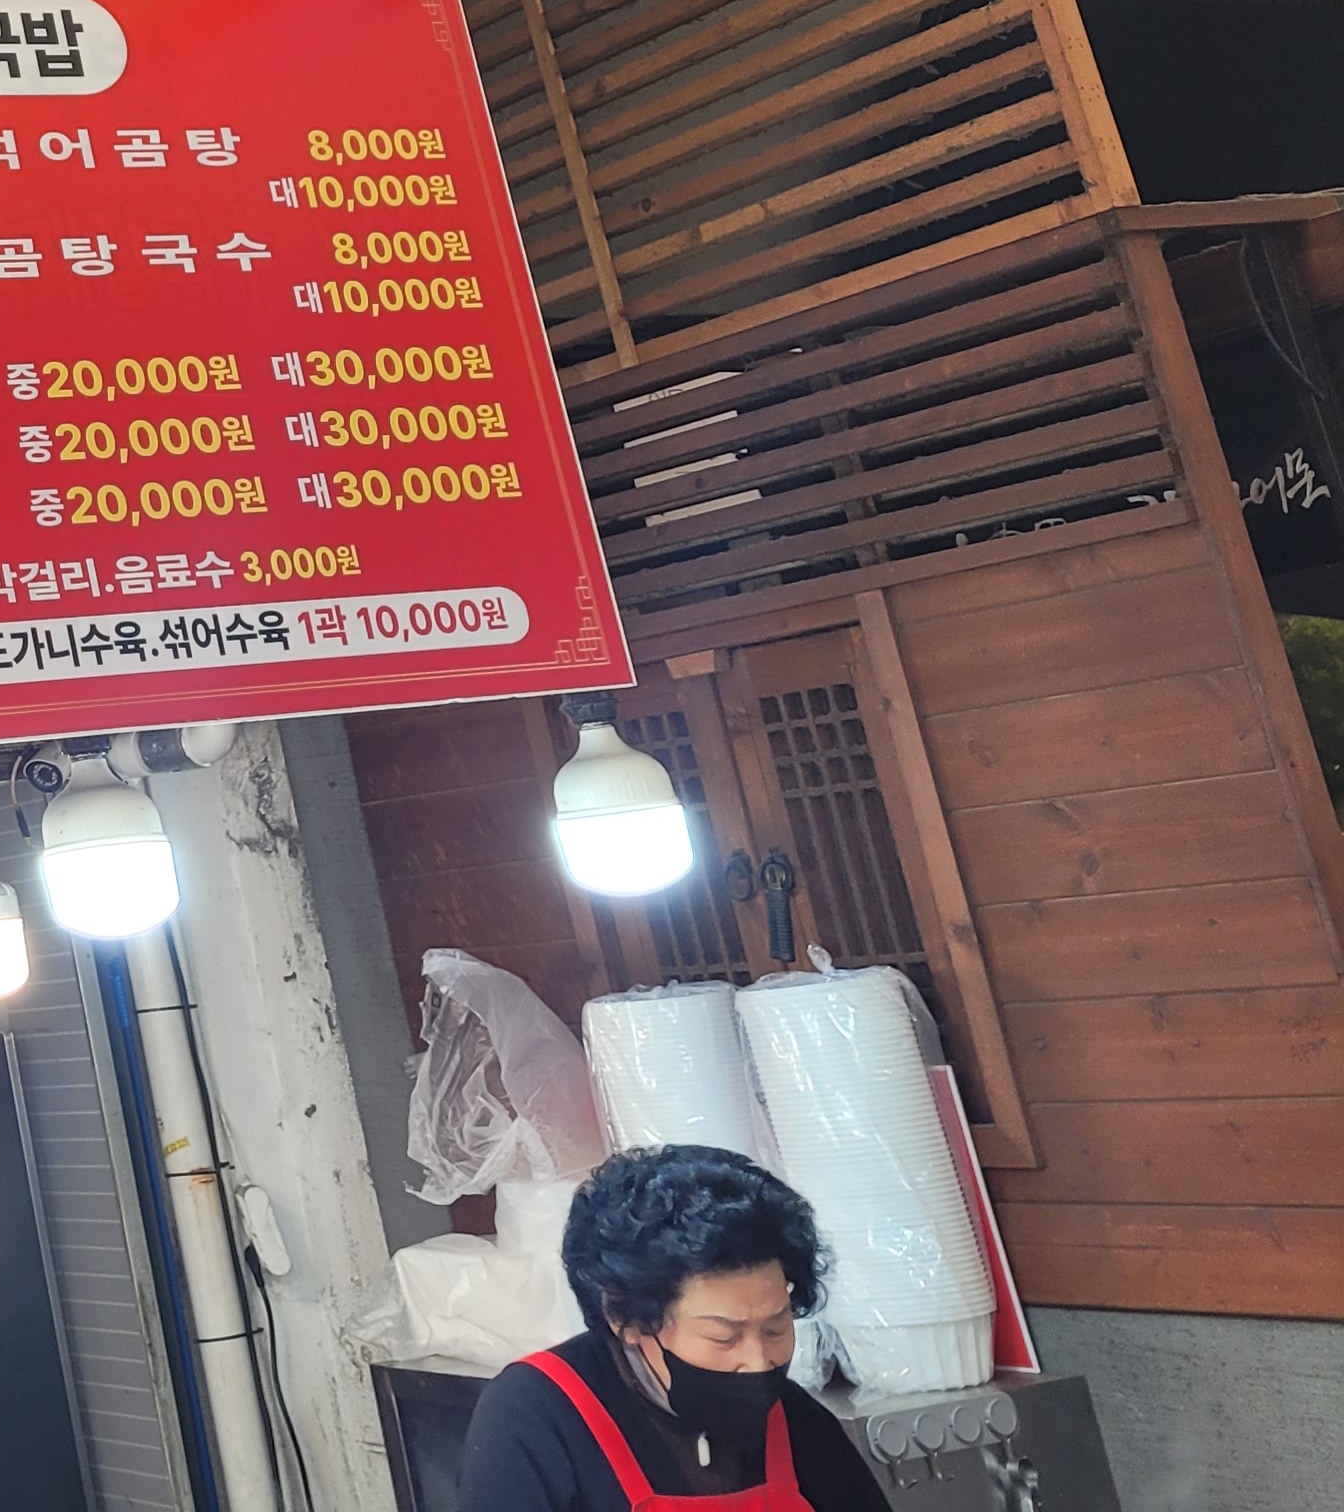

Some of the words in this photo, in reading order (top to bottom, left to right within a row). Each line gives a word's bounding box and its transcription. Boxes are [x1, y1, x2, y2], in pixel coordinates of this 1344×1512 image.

[308, 129, 445, 165] 8,000원
[269, 175, 457, 212] 대10,000원
[333, 231, 471, 269] 8,000원
[293, 277, 483, 316] 대10,000원
[7, 355, 241, 401] 중20,000원
[271, 345, 493, 389] 대30,000원
[20, 415, 255, 463] 중20,000원
[285, 403, 508, 449] 대30,000원
[31, 477, 267, 526] 중20,000원
[298, 463, 522, 510] 대30,000원
[241, 545, 361, 585] 3,000원
[298, 605, 348, 645] 1곽
[357, 598, 508, 642] 10,000원
